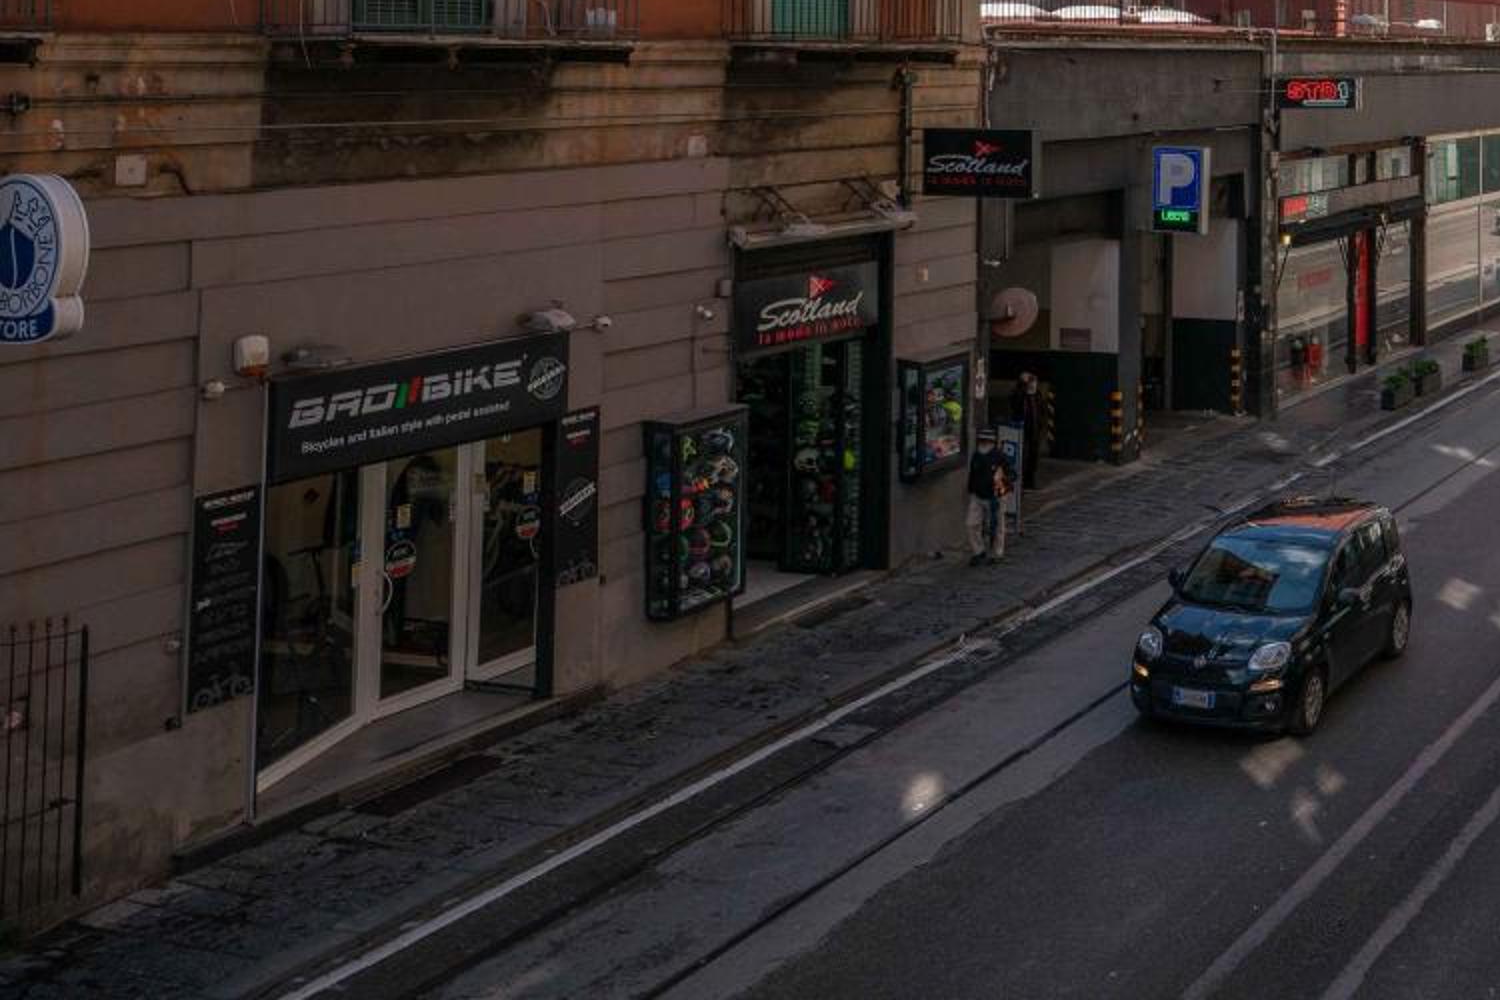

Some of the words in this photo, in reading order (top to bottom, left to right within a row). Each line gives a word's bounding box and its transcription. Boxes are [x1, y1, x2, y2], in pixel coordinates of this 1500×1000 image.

[926, 154, 1029, 175] Scotland
[1159, 153, 1194, 205] P
[757, 291, 864, 332] Scotland
[421, 360, 521, 402] BIKE
[347, 430, 367, 445] and
